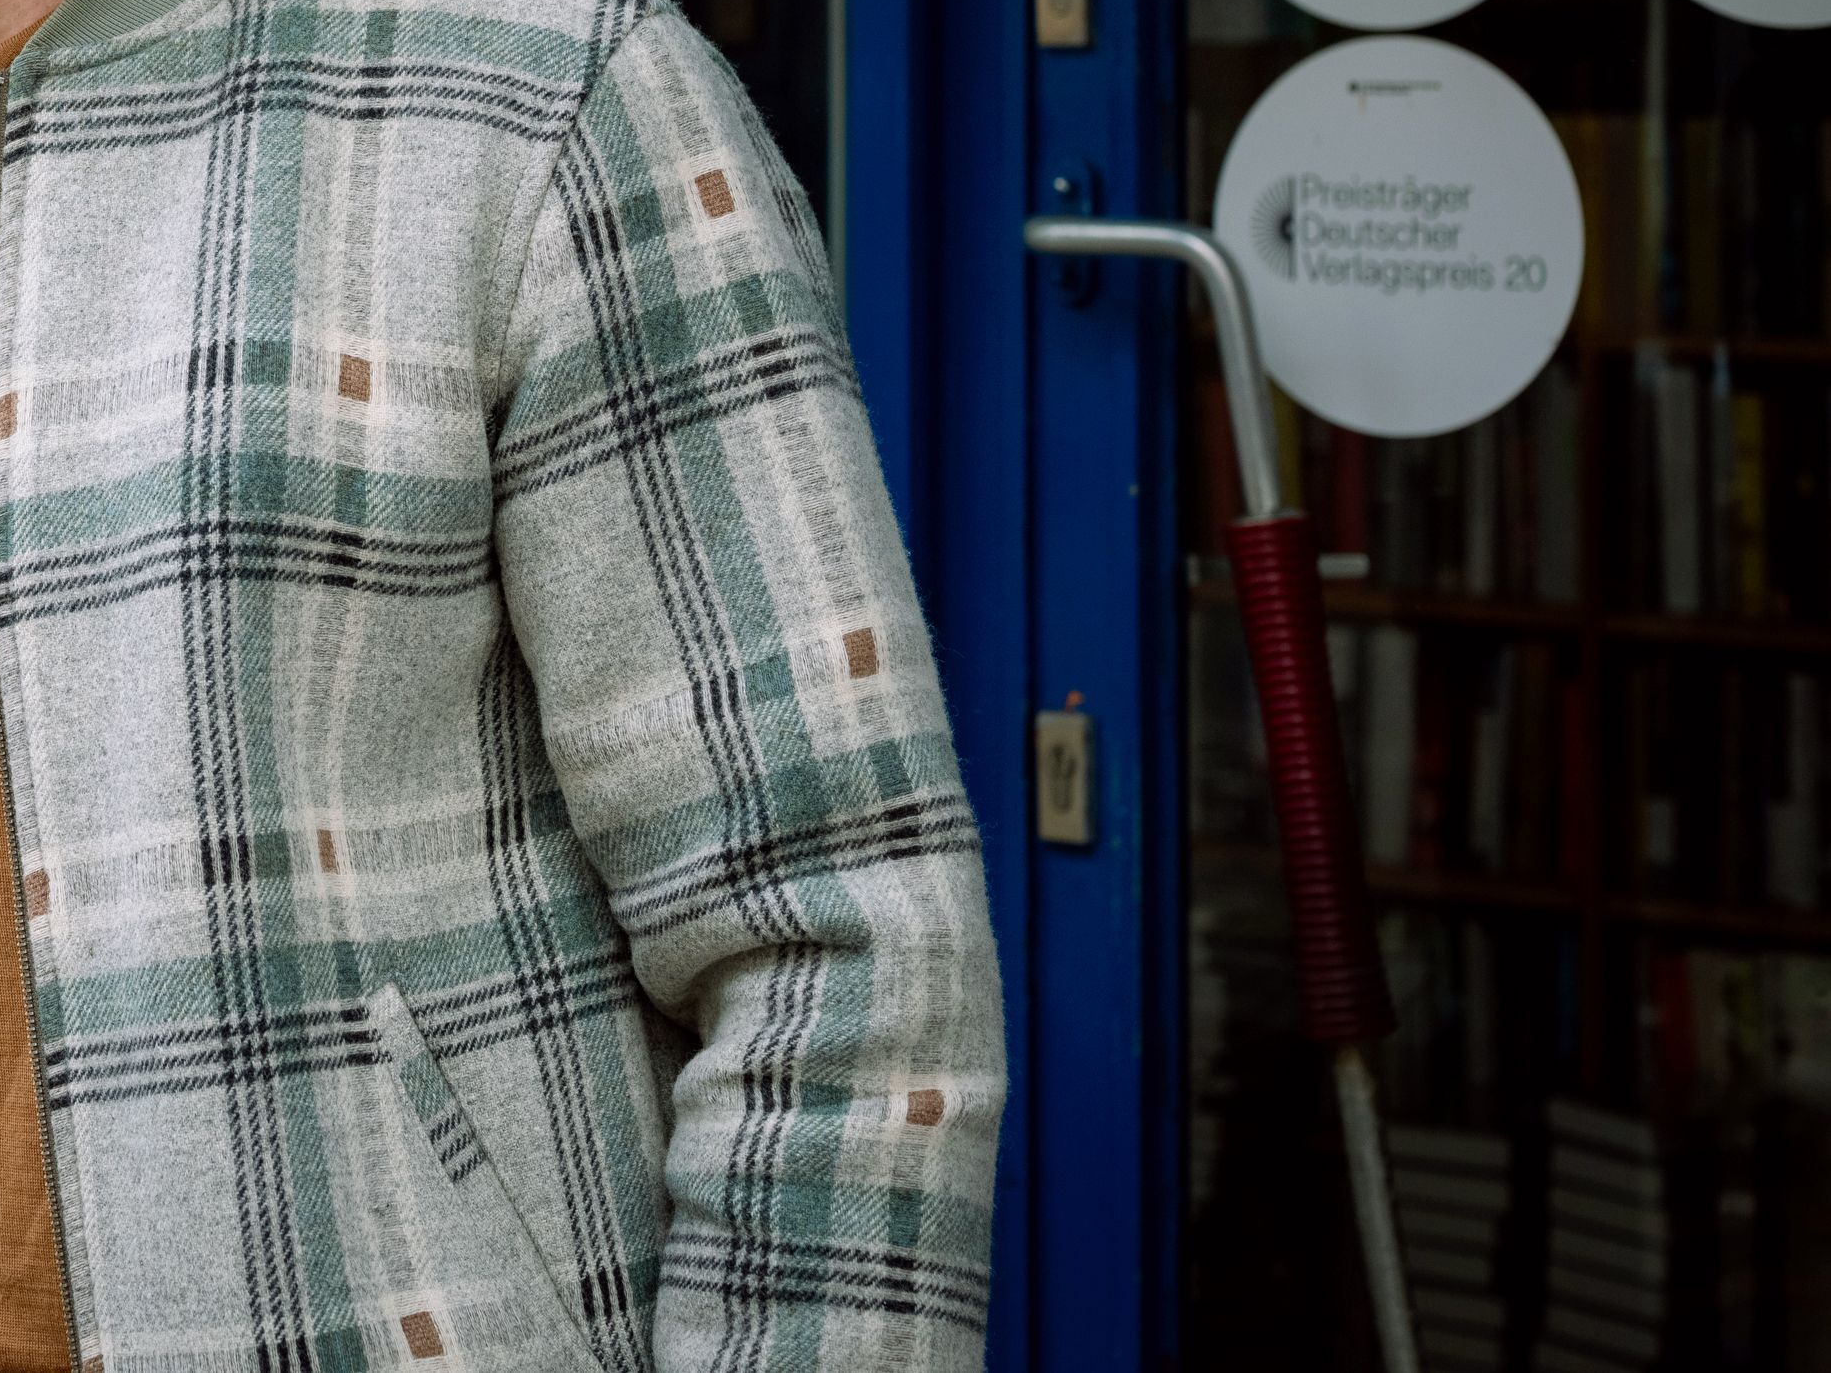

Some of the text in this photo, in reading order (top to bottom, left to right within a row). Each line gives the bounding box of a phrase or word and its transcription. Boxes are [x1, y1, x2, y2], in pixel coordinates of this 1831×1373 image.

[1300, 172, 1474, 220] Preisträger
[1301, 211, 1461, 251] Deutscher
[1301, 250, 1549, 296] Verlagspreis 20
